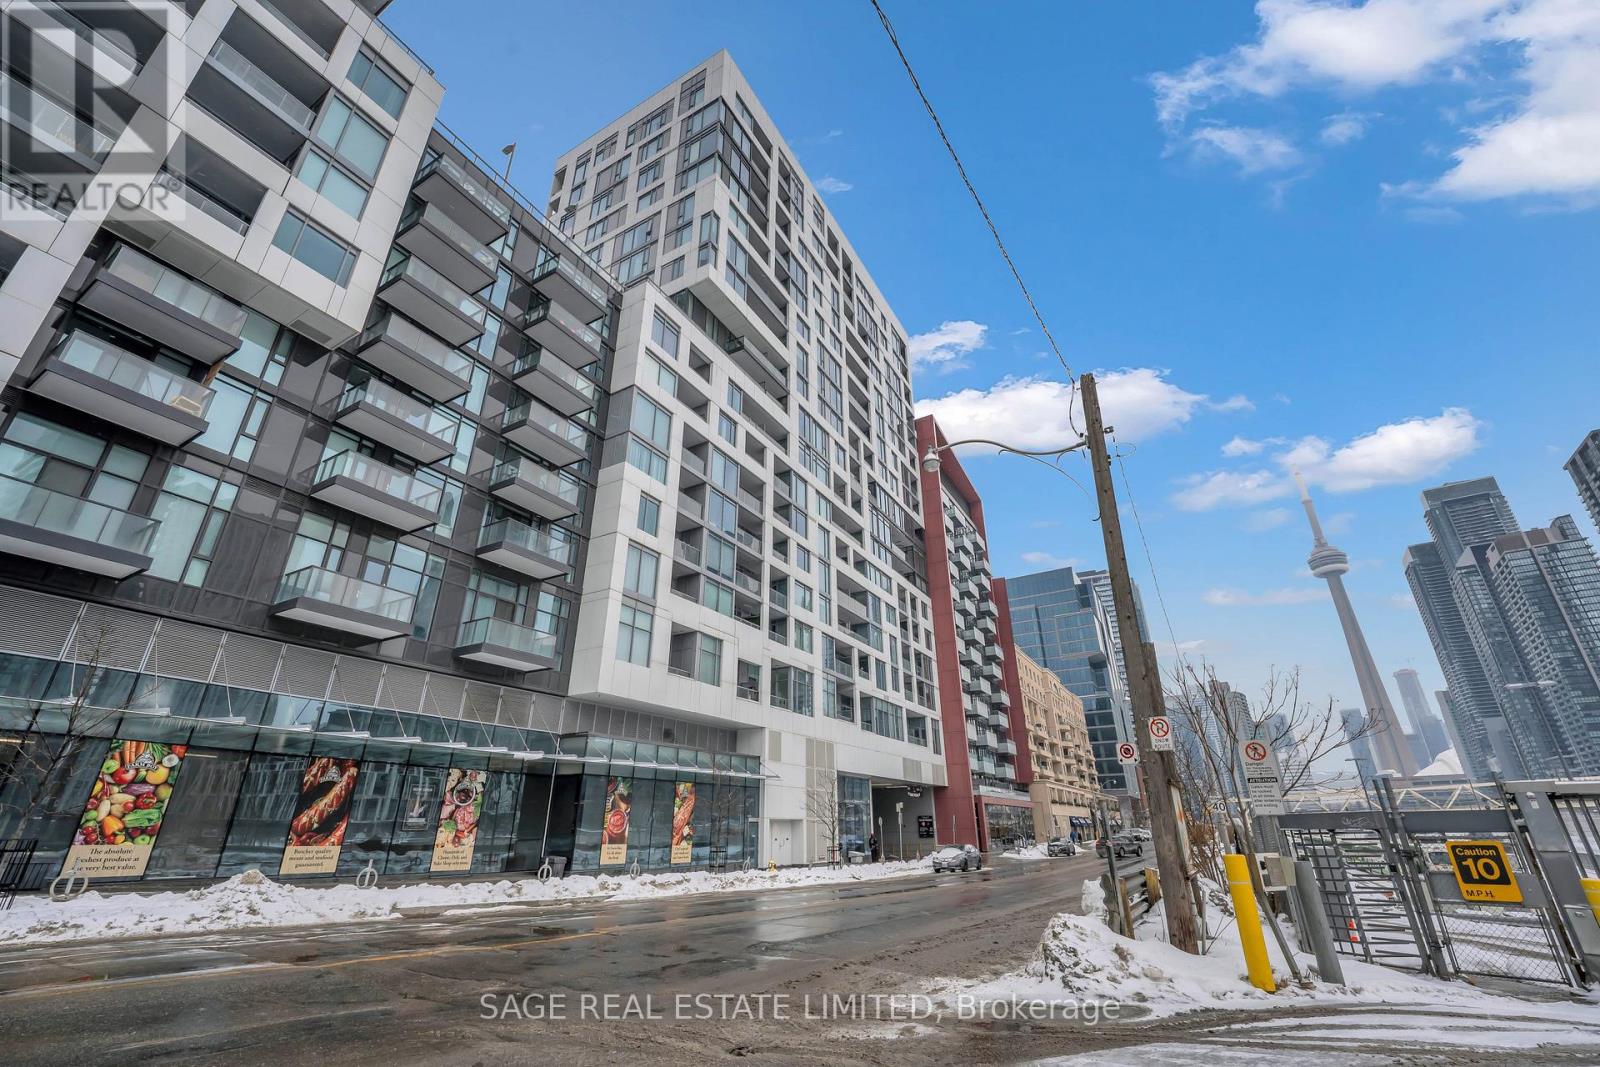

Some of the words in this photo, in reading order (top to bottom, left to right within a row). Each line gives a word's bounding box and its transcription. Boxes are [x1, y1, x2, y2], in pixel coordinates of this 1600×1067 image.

[1212, 802, 1226, 812] 40
[103, 847, 133, 855] absolute
[1455, 847, 1497, 856] Caution
[103, 855, 131, 864] produce
[101, 863, 116, 871] best
[1461, 857, 1501, 880] 10
